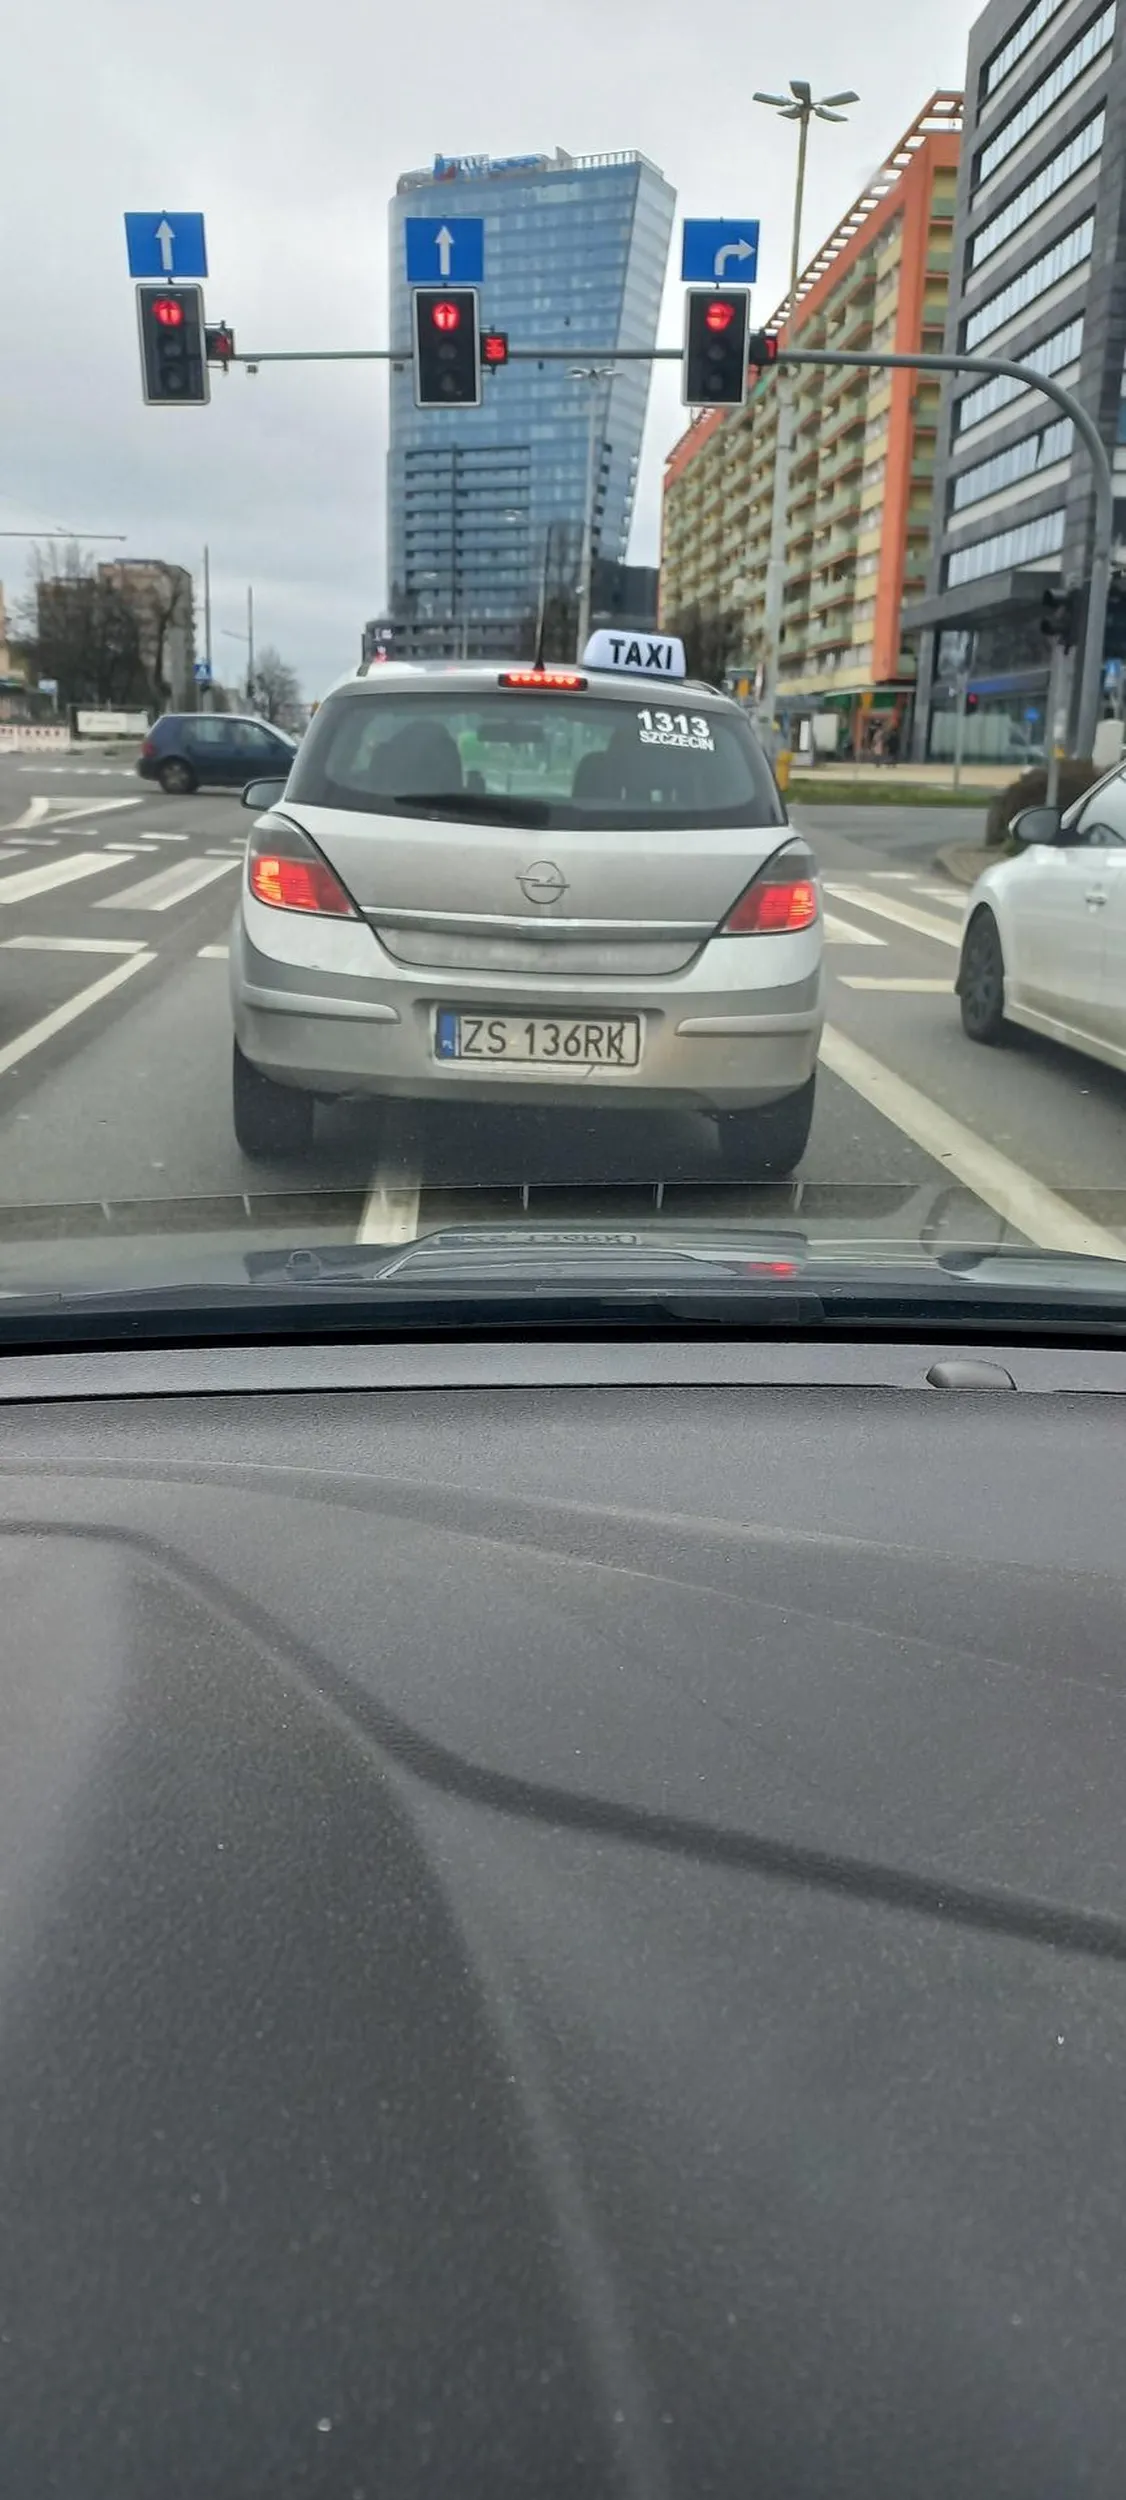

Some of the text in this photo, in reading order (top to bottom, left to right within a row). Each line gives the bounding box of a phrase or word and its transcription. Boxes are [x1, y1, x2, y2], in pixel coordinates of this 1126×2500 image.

[609, 638, 673, 670] TAXI
[637, 709, 710, 737] 1313
[639, 730, 715, 751] SZCZECIN
[463, 1020, 625, 1059] ZS 136RK
